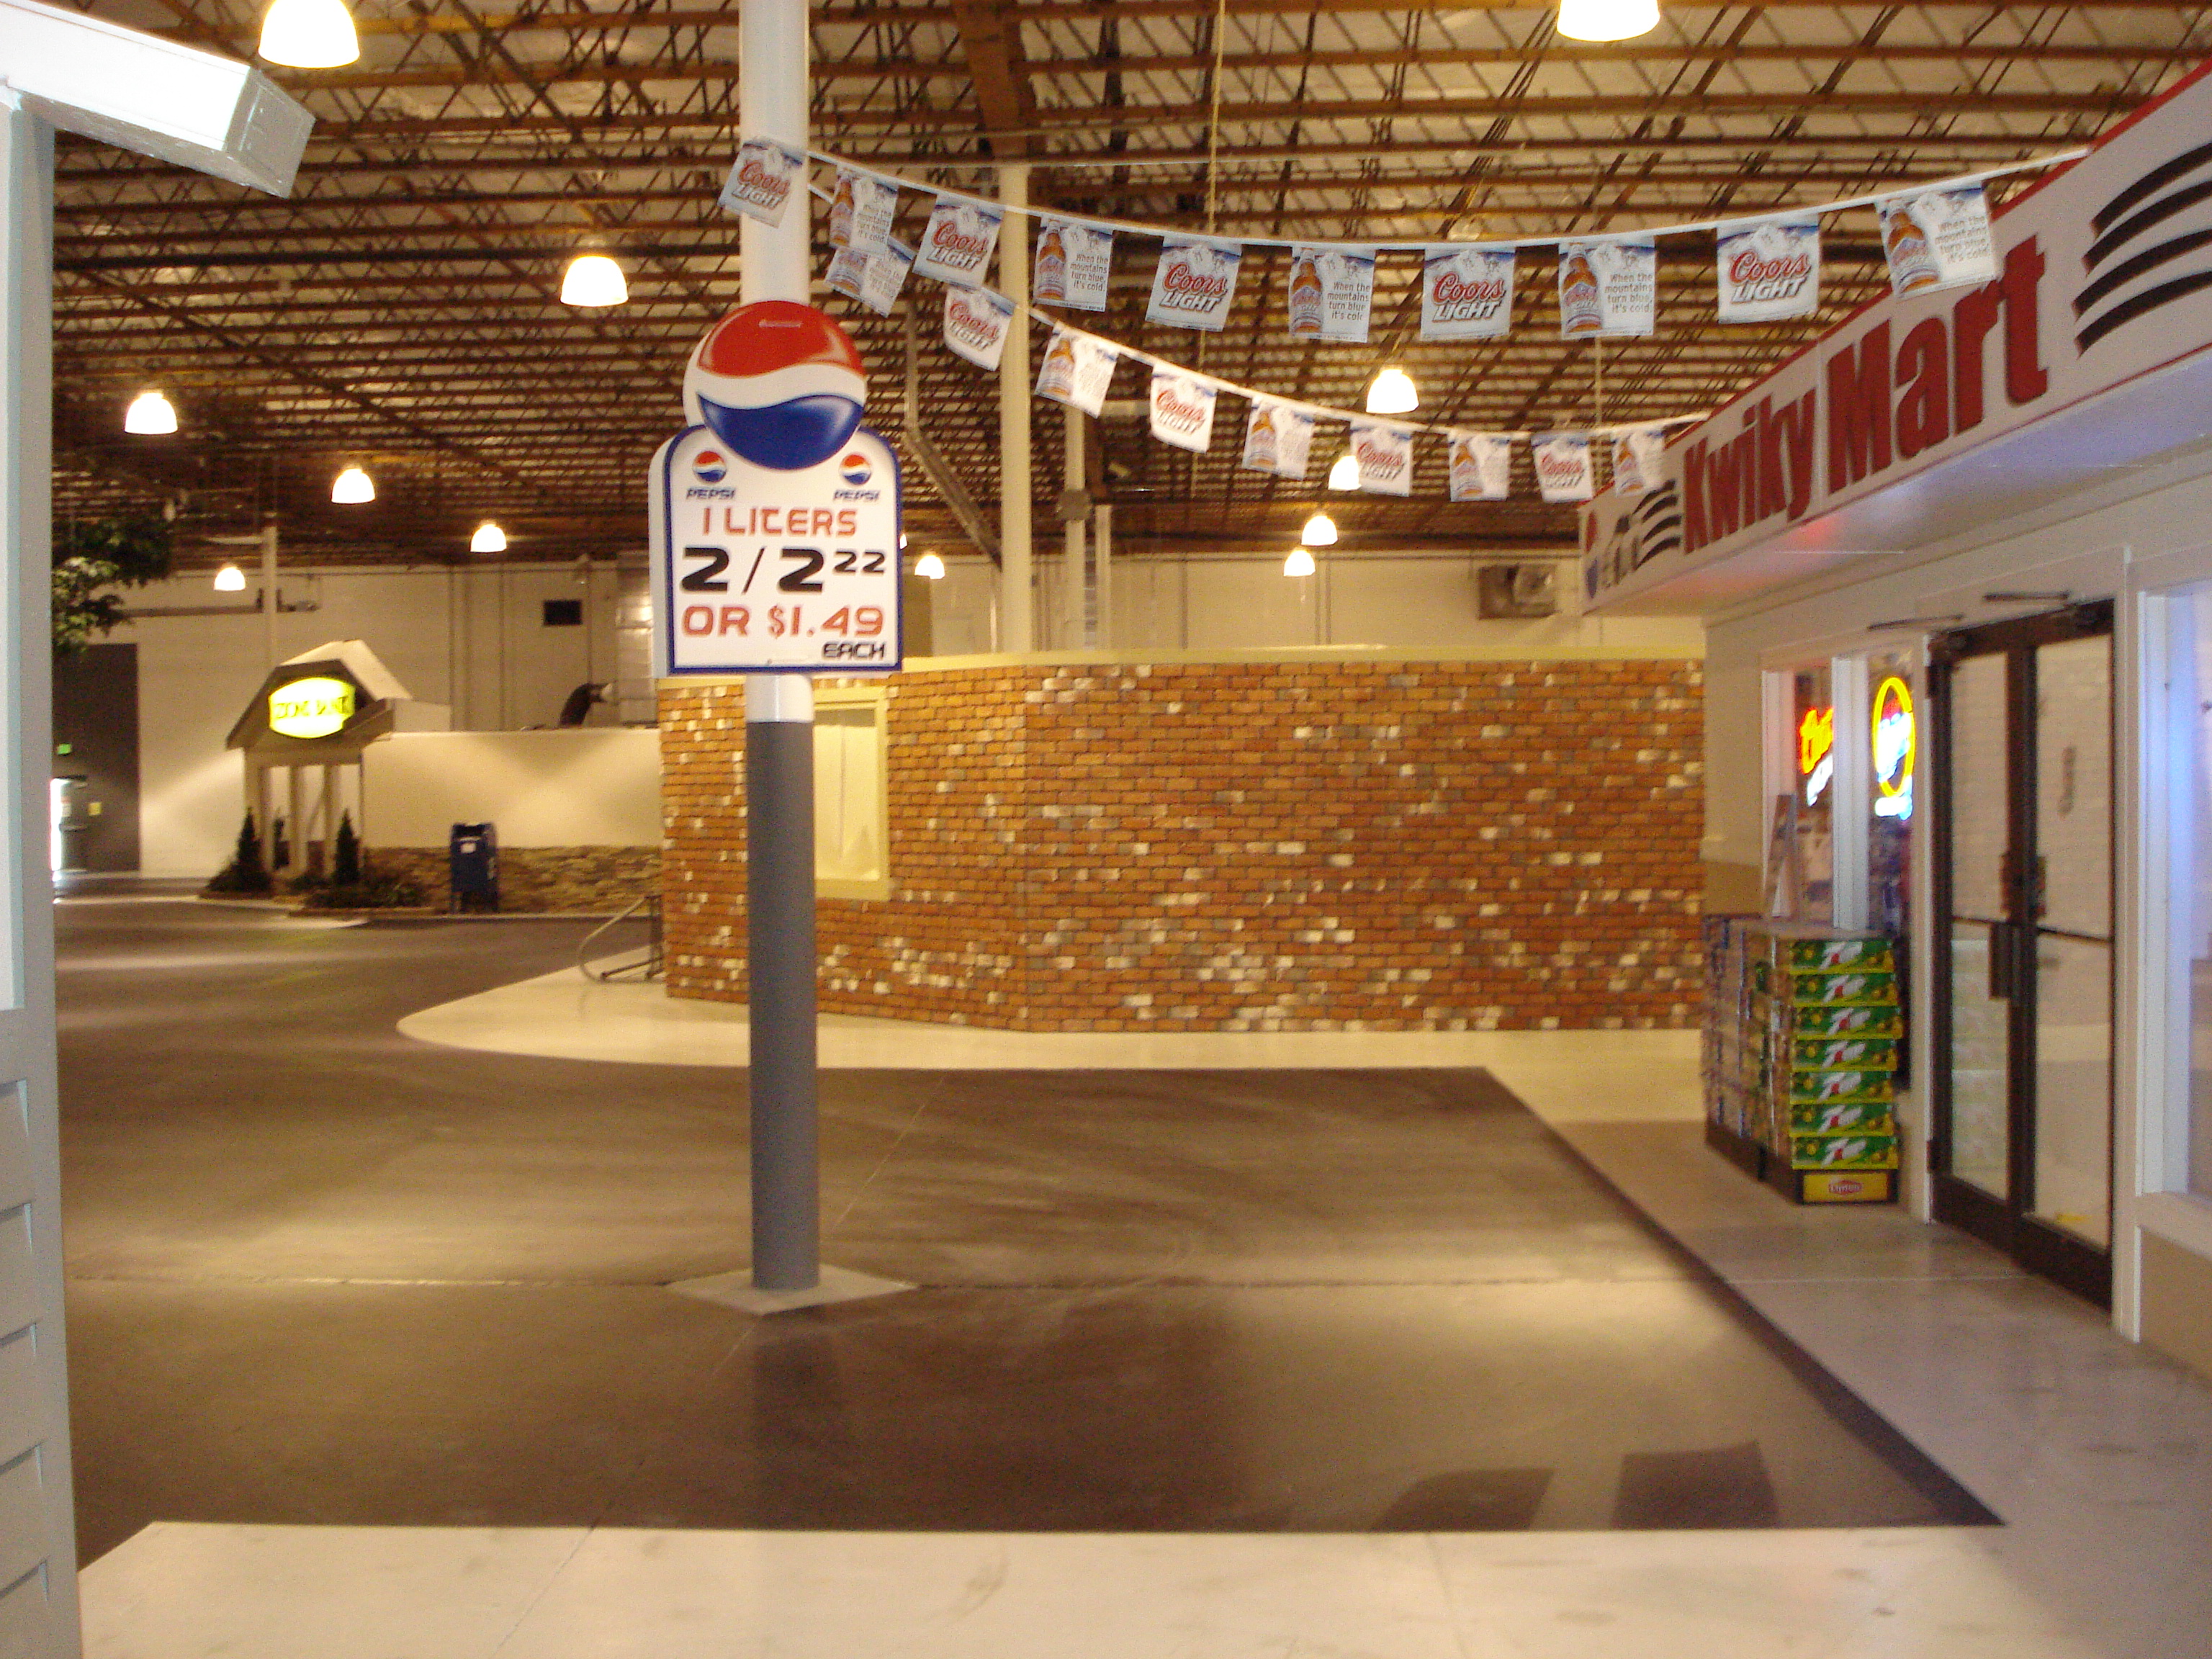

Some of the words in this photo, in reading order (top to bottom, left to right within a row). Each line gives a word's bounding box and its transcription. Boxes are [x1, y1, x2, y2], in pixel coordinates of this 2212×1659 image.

[737, 160, 790, 195] Coors
[732, 184, 784, 210] LIGHT
[932, 220, 987, 256] Coors
[927, 247, 982, 271] LIGHT
[1071, 263, 1107, 274] mountains
[1076, 253, 1094, 263] When
[1097, 255, 1108, 264] the
[1730, 250, 1811, 286] Coors
[1071, 271, 1086, 281] turn
[1074, 280, 1084, 289] it's
[1163, 262, 1228, 297] Coors
[1610, 274, 1635, 282] When
[1334, 282, 1354, 291] When
[1357, 283, 1370, 292] the
[1432, 271, 1506, 305] Coors
[1604, 284, 1653, 294] mountains
[1732, 277, 1807, 304] LIGHT
[1159, 292, 1223, 313] LIGHT
[1607, 295, 1627, 303] turn
[1612, 303, 1626, 313] it's
[950, 300, 999, 340] Coors
[1432, 302, 1501, 322] LIGHT
[1683, 387, 1817, 555] Kwiky
[1826, 233, 2047, 495] Mart
[686, 487, 735, 499] PEPSI
[833, 490, 880, 501] PEPSI
[683, 606, 749, 637] OR
[768, 605, 884, 639] $1.49
[823, 643, 885, 659] EACH
